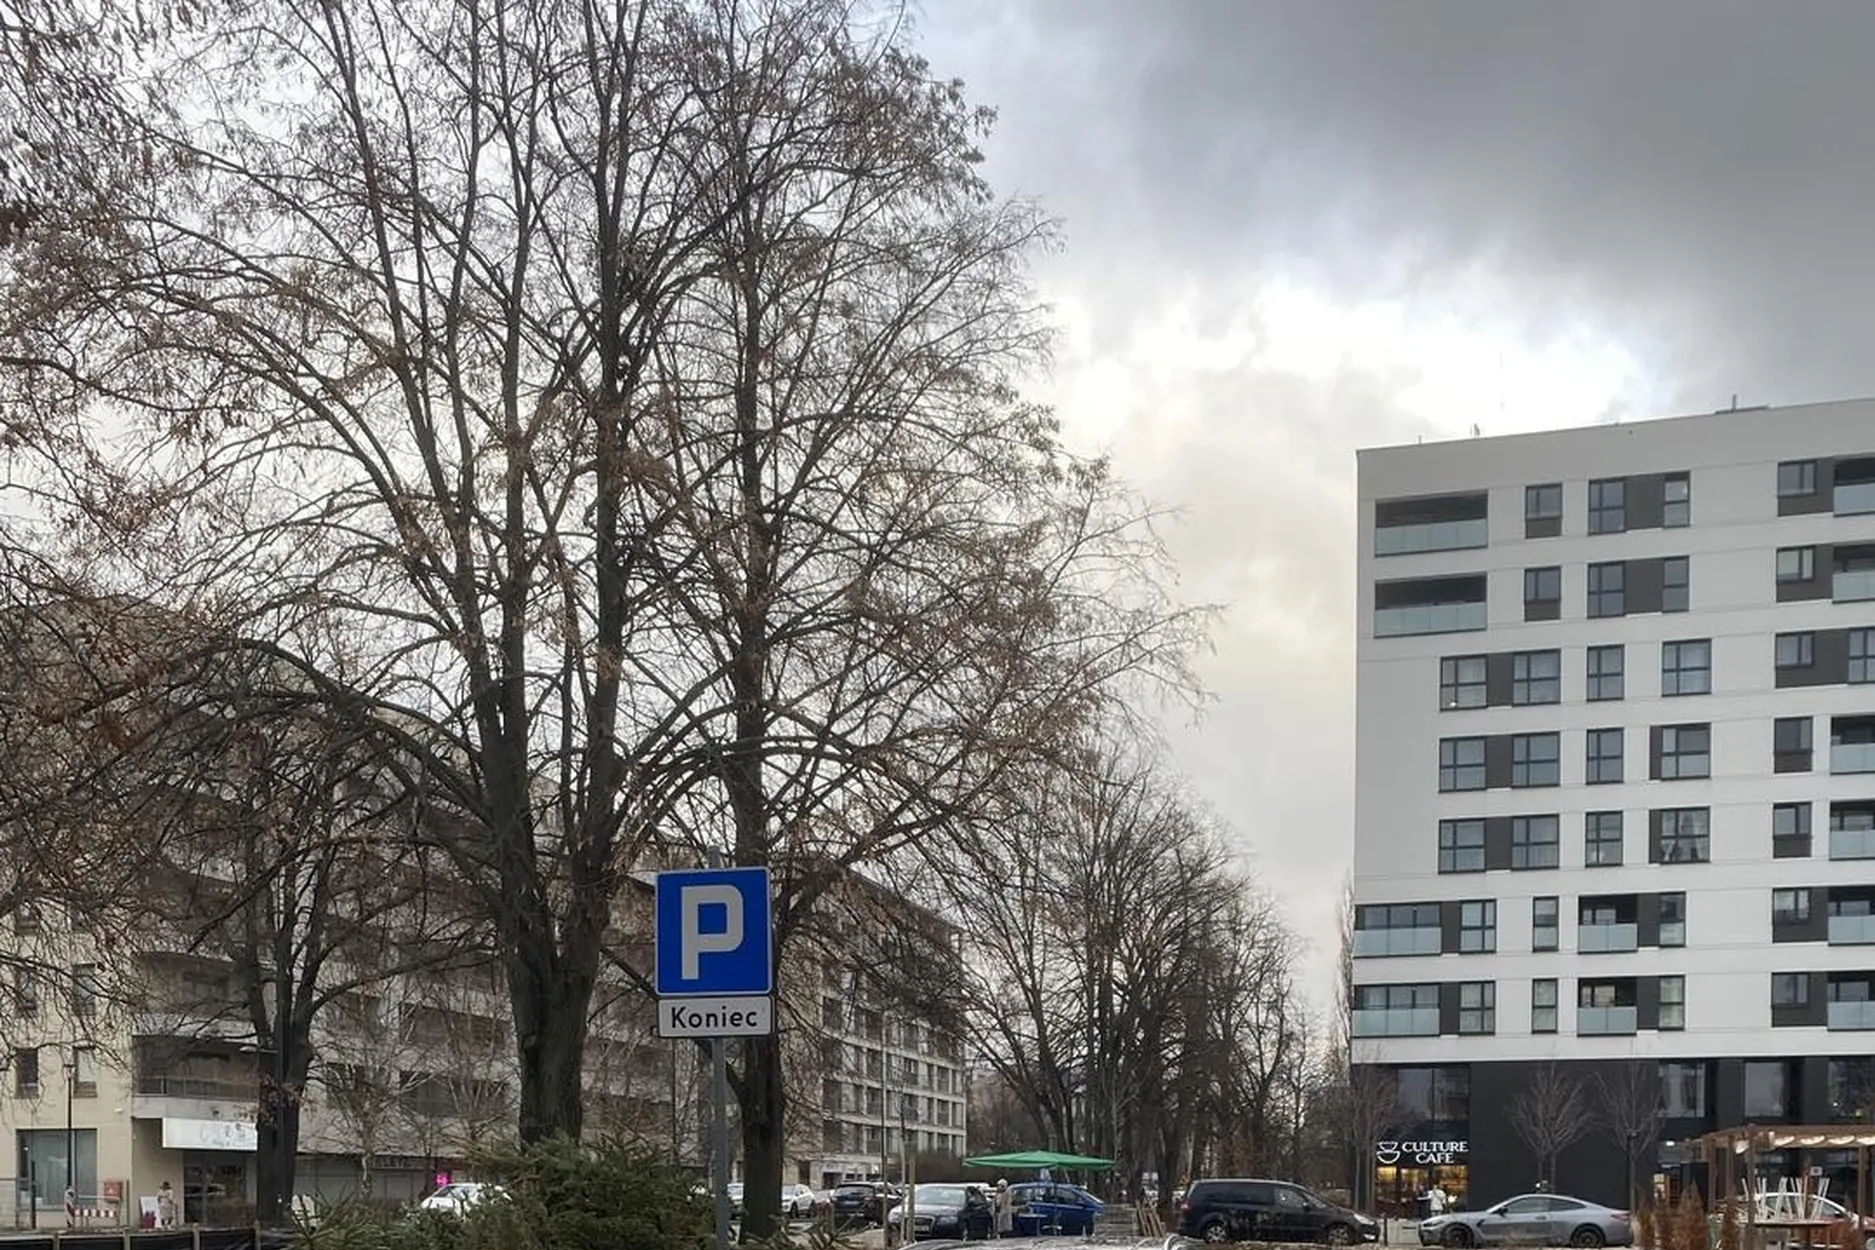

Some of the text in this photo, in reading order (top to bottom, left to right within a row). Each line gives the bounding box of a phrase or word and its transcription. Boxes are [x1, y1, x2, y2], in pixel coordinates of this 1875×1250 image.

[681, 884, 744, 980] P
[671, 1005, 757, 1028] Koniec
[1402, 1141, 1469, 1152] CULTURE
[1416, 1152, 1454, 1163] CAFE
